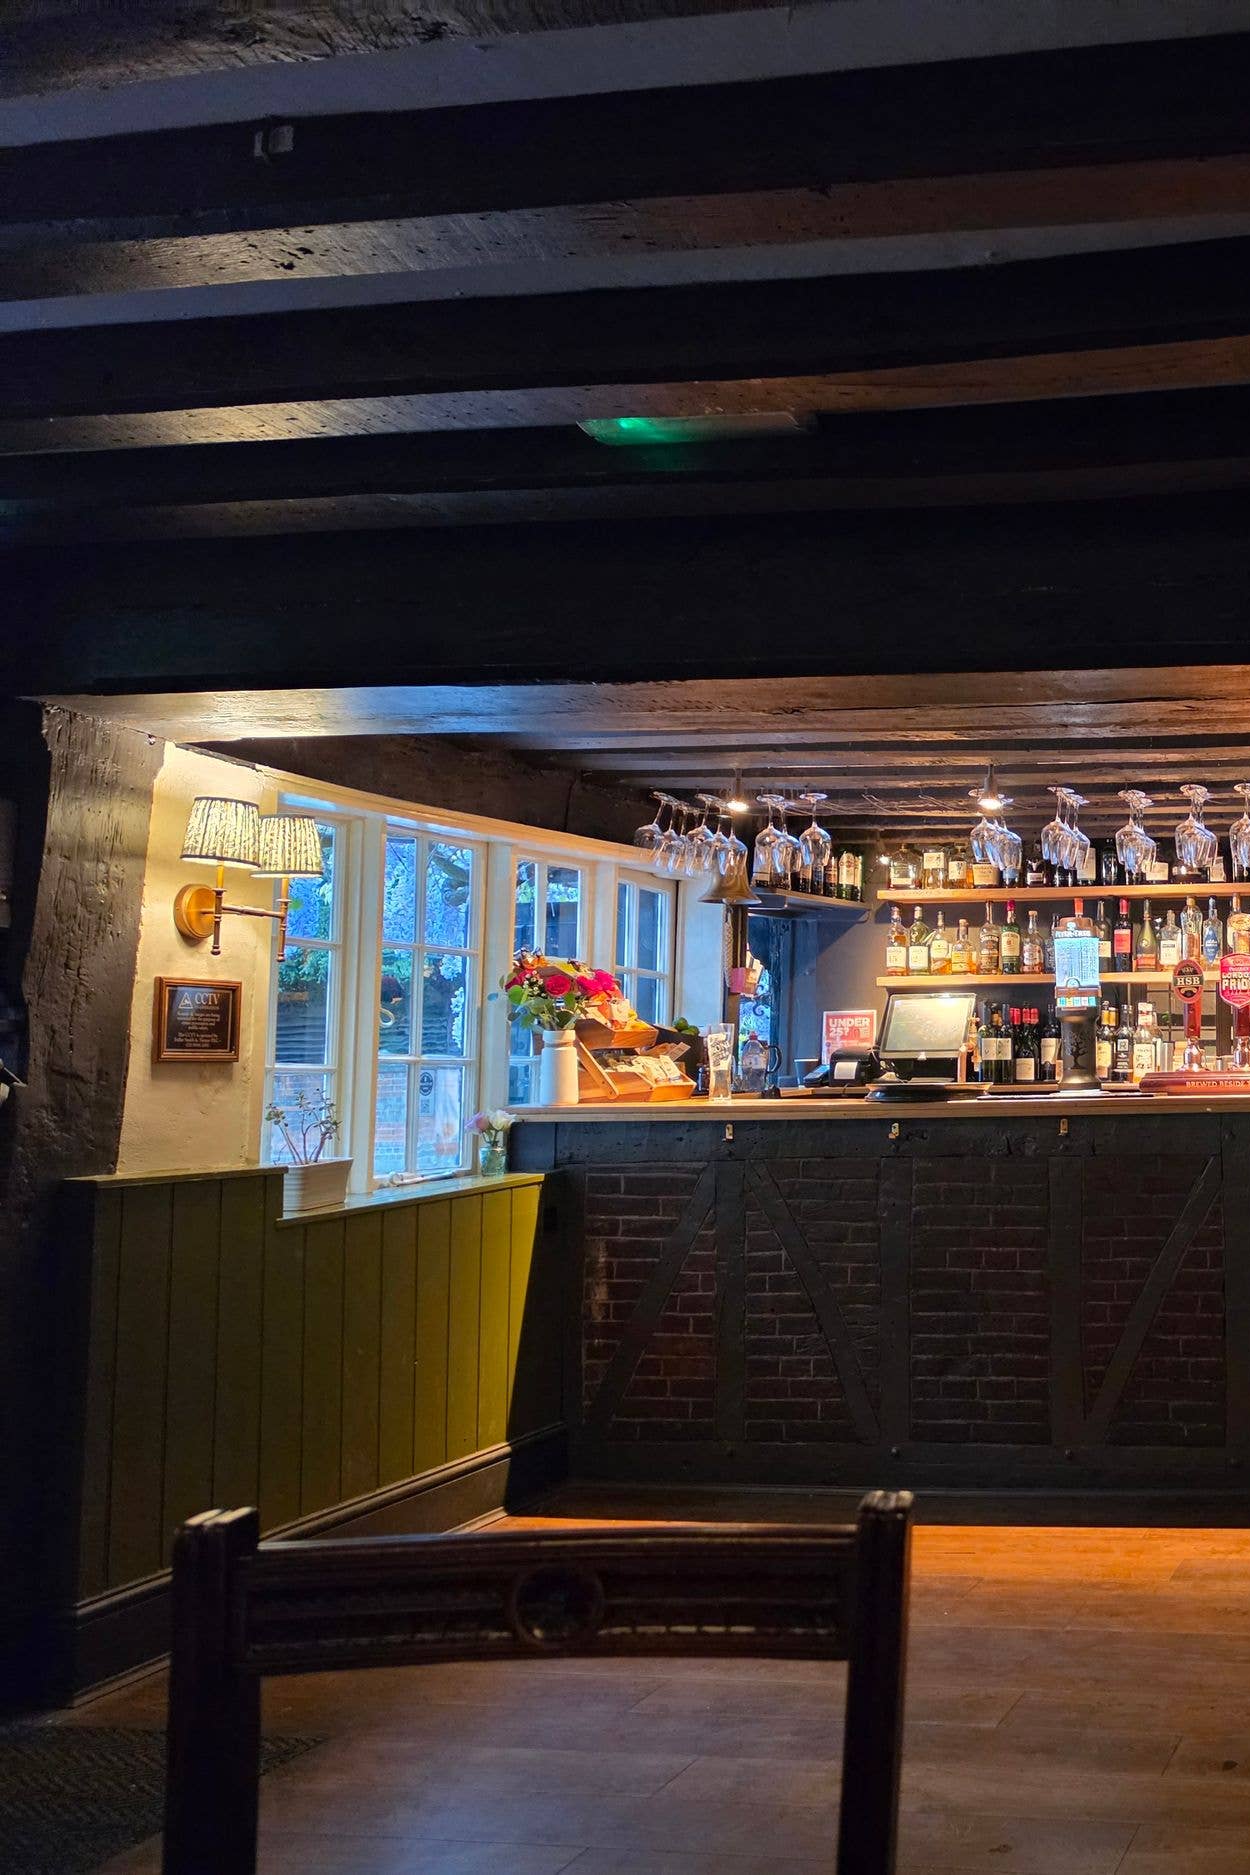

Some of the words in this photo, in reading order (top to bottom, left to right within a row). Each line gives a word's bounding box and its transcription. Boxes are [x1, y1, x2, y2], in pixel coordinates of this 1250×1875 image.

[1177, 976, 1200, 986] HSB
[195, 992, 220, 1005] CCTV
[829, 1017, 871, 1028] UNDER
[829, 1027, 850, 1037] 25?
[1185, 1080, 1217, 1088] BREWED
